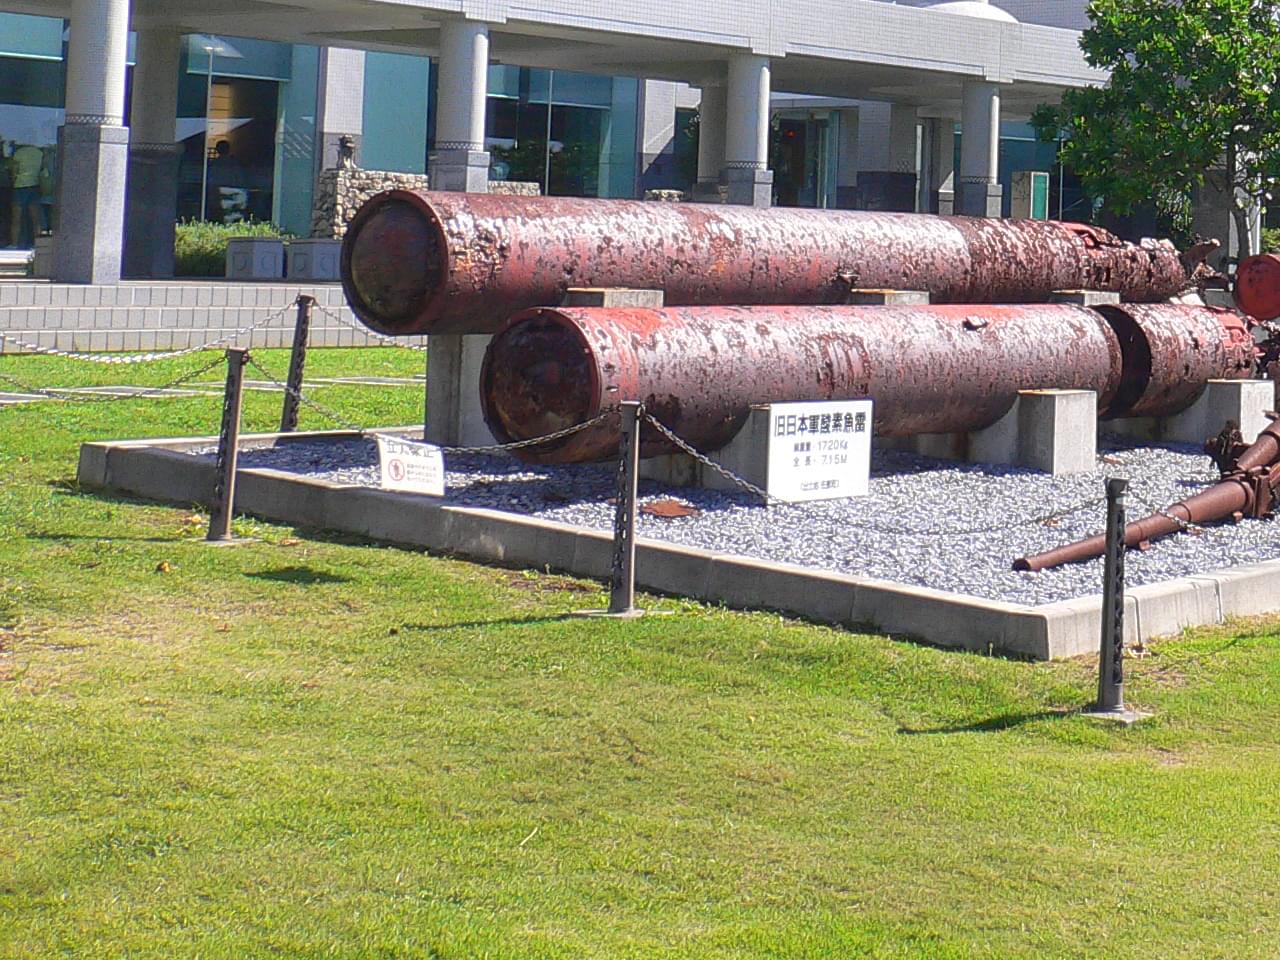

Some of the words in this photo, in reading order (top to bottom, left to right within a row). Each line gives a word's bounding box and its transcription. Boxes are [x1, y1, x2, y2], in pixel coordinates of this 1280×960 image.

[774, 412, 866, 437] 旧日本軍酸素魚雷
